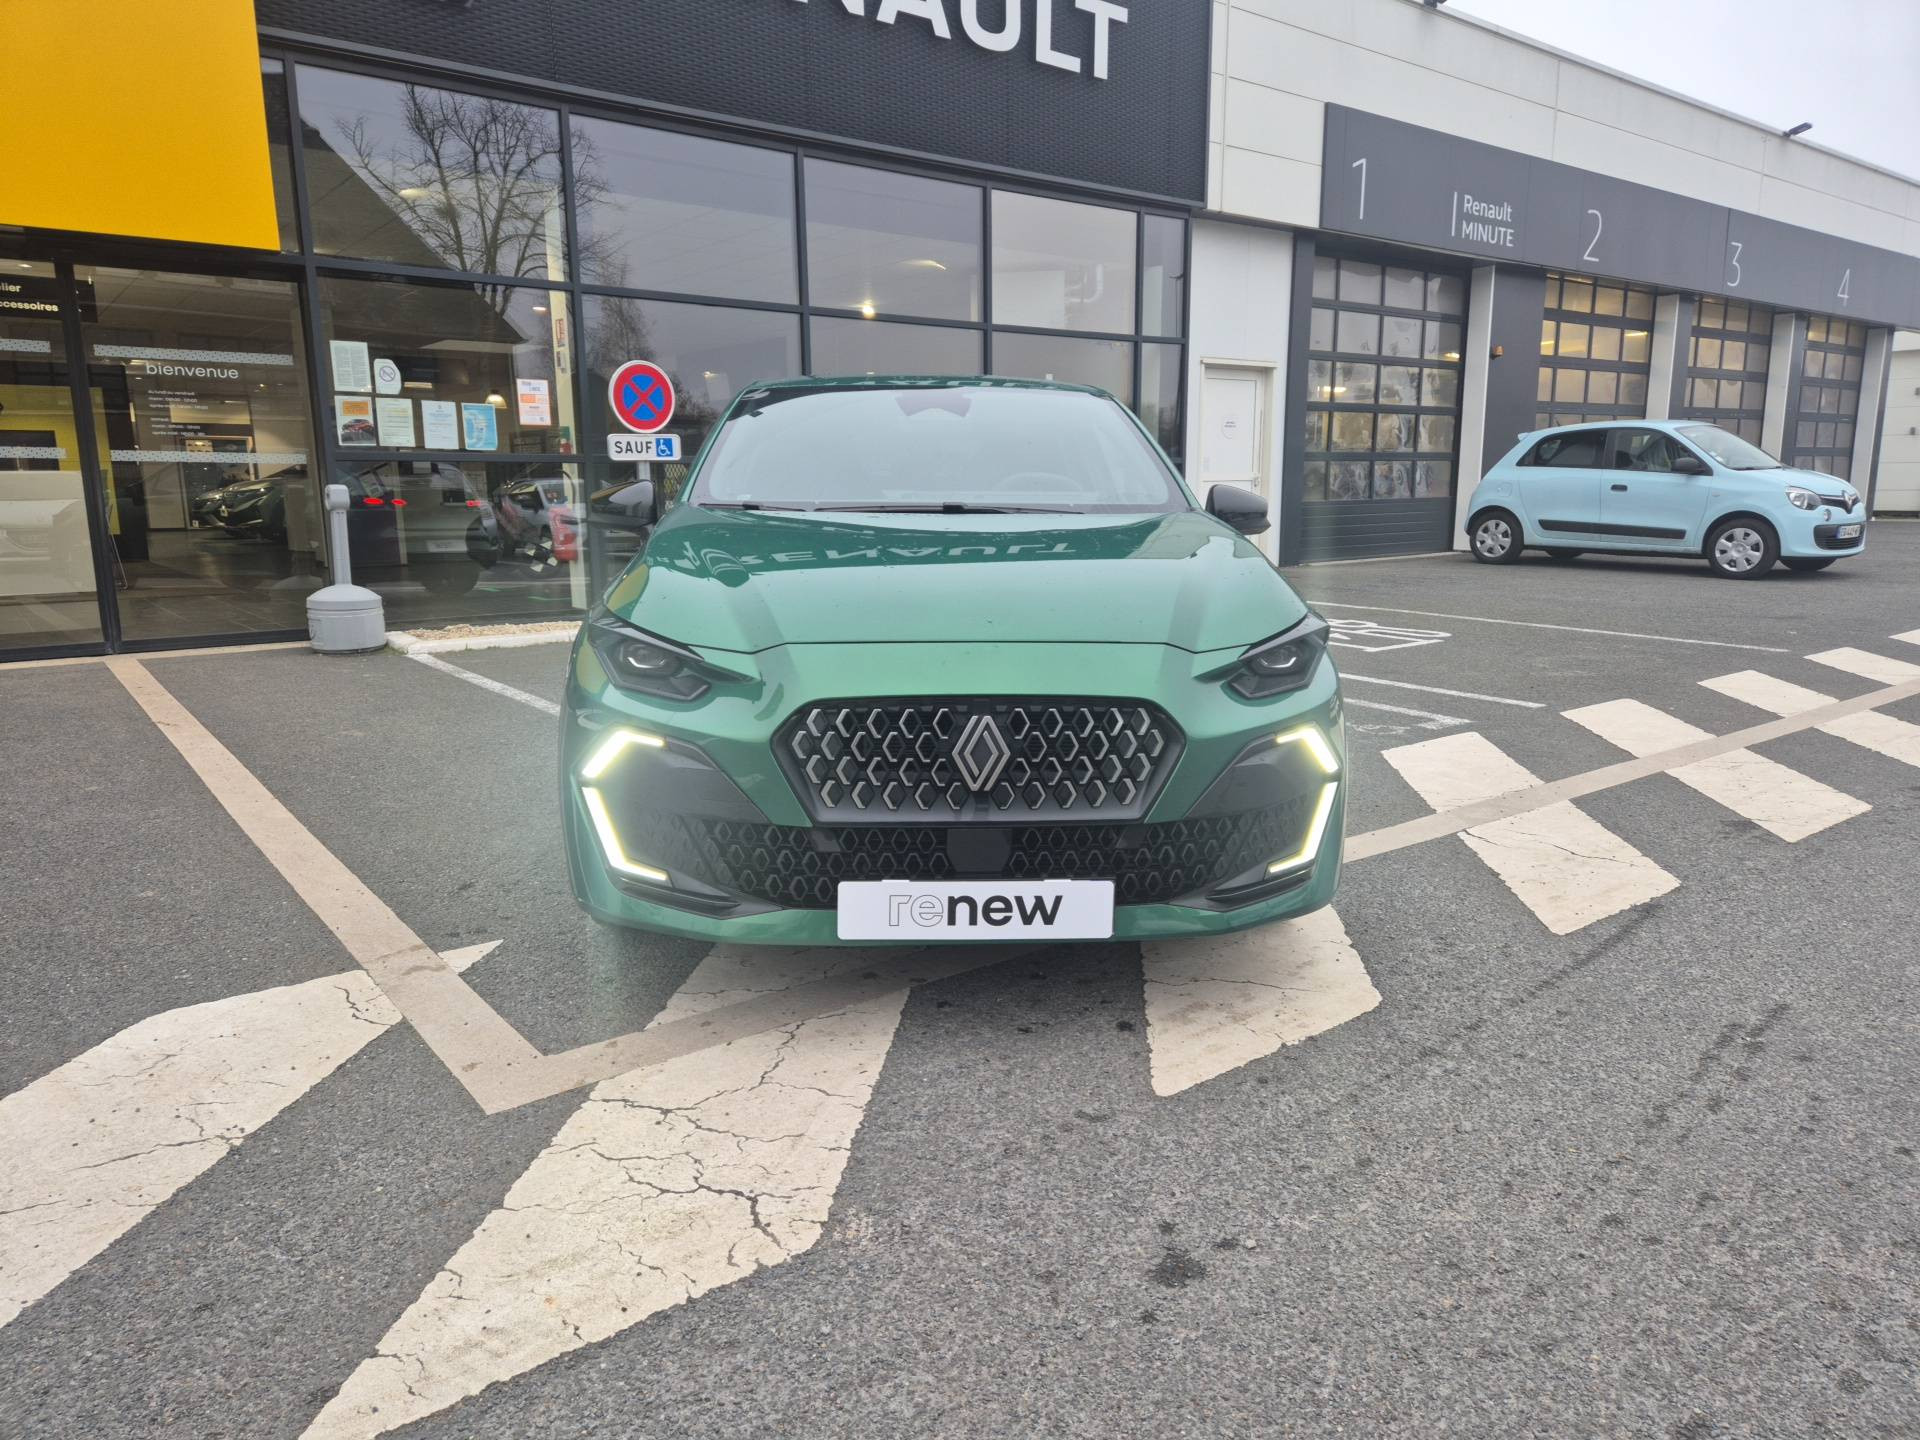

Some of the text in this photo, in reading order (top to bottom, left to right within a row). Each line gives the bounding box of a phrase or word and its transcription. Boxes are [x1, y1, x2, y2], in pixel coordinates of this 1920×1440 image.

[1352, 158, 1367, 220] 1
[1463, 194, 1513, 222] Renault
[1462, 219, 1515, 247] MINUTE
[1583, 209, 1602, 262] 2
[1727, 241, 1743, 287] 3
[1837, 268, 1851, 307] 4
[145, 361, 239, 379] bienvenue
[614, 441, 653, 454] SAUF
[889, 895, 1063, 927] renew
